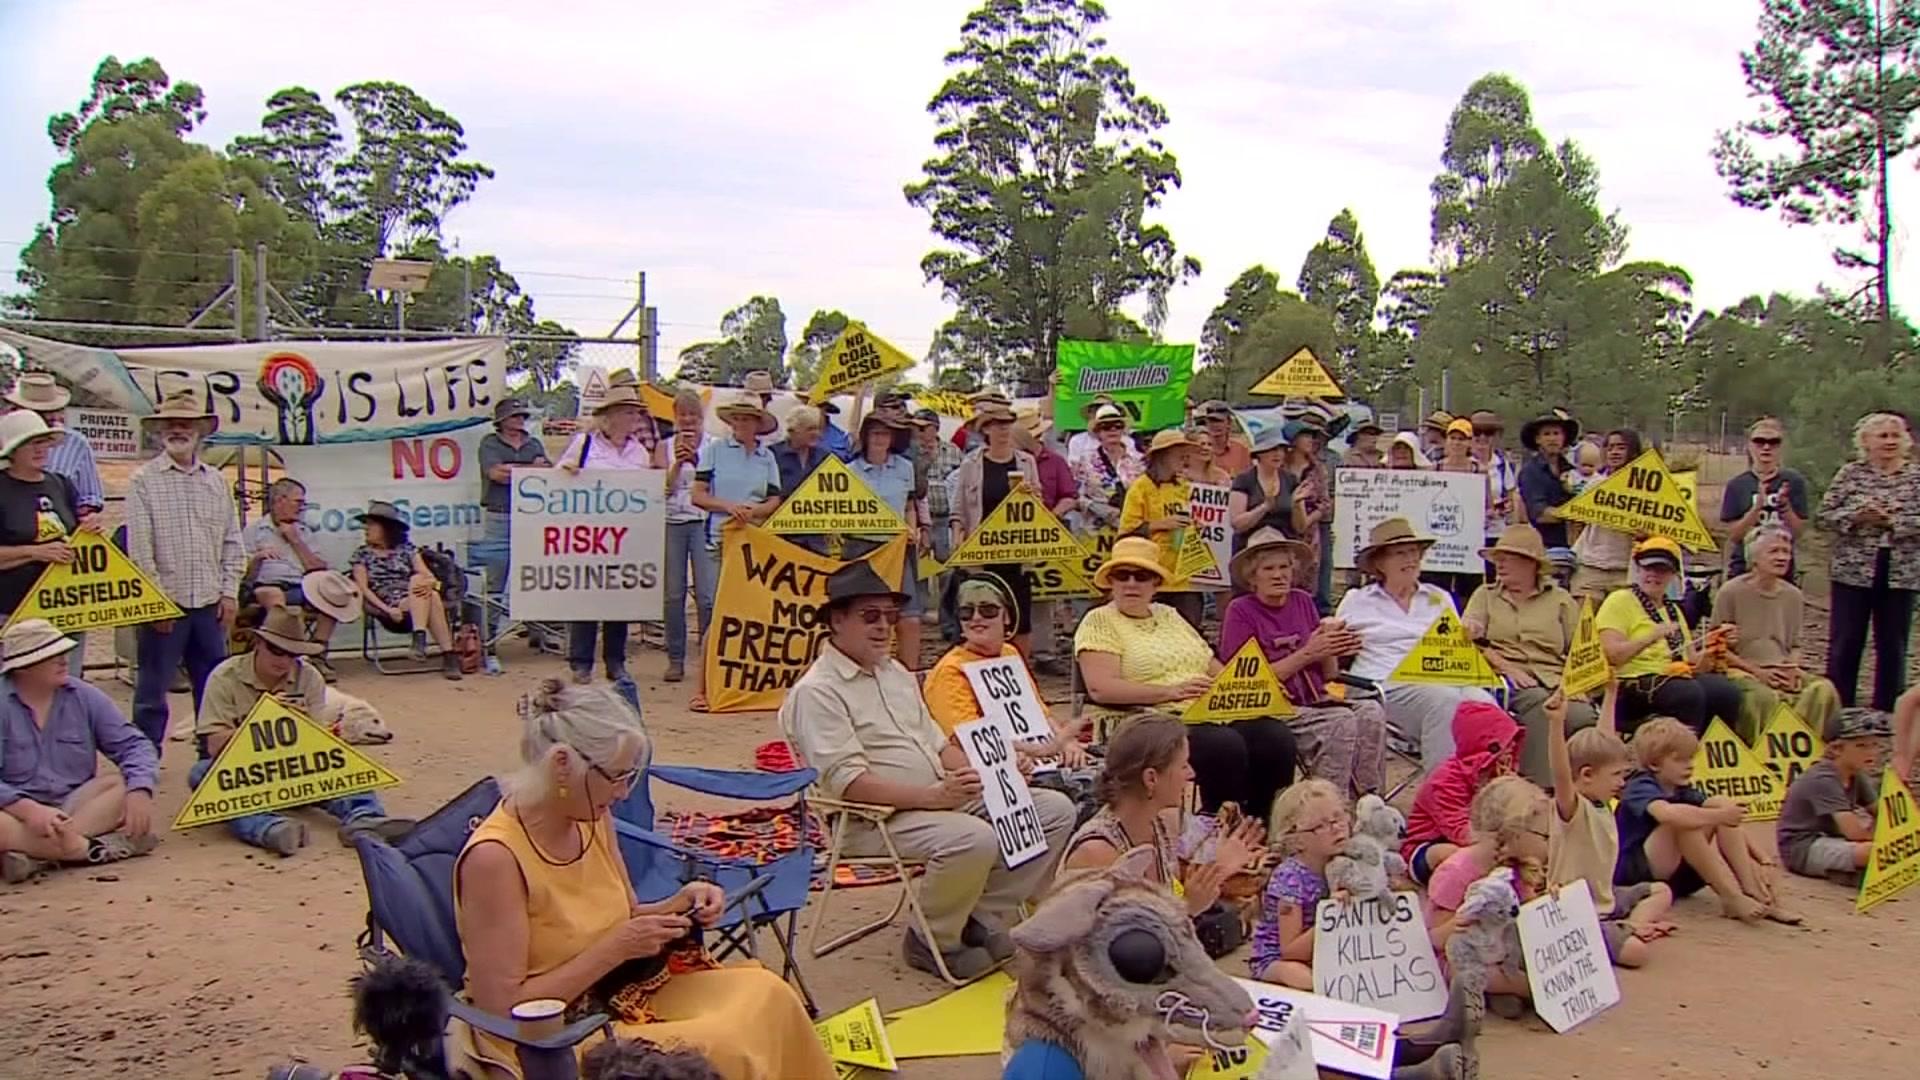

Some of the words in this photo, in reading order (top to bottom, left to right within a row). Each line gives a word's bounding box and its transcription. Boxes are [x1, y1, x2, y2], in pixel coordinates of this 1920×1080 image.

[838, 342, 877, 366] COAL
[846, 332, 864, 349] NO
[847, 355, 881, 380] CSG
[334, 369, 378, 425] IS
[394, 359, 491, 418] LIFE
[79, 413, 129, 427] PRIVATE
[107, 442, 137, 454] ENTER
[391, 437, 463, 481] NO
[817, 472, 849, 493] NO
[1627, 466, 1664, 493] NO
[517, 474, 648, 516] Santos
[791, 499, 878, 515] GASFIELDS
[1190, 487, 1230, 506] ARM
[1431, 503, 1460, 514] SAVE
[1593, 488, 1686, 524] GASFIELDS
[302, 501, 366, 533] Coa
[772, 518, 826, 529] PROTECT
[830, 518, 856, 528] OUR
[857, 518, 898, 528] WATER
[1006, 501, 1035, 523] NO
[1190, 505, 1227, 524] NOT
[1569, 504, 1626, 525] PROTECT
[1629, 516, 1656, 532] OUR
[1657, 525, 1703, 543] WATER
[543, 525, 629, 556] RISKY
[979, 527, 1060, 547] GASFIELDS
[1201, 526, 1225, 542] AS
[71, 544, 109, 575] NO
[960, 549, 1010, 561] PROTECT
[1014, 548, 1038, 559] OUR
[1040, 546, 1078, 558] WATER
[520, 562, 658, 592] BUSINESS
[741, 543, 831, 597] WAT
[1027, 568, 1063, 588] AS
[38, 578, 144, 610] GASFIELDS
[47, 612, 84, 628] TECT
[88, 607, 119, 624] OUR
[120, 601, 167, 619] WATER
[773, 598, 828, 631] MO
[980, 665, 1023, 700] CSG
[1234, 657, 1260, 679] NO
[1217, 679, 1269, 692] NARRABRI
[1208, 691, 1272, 711] GASFIELD
[1003, 701, 1030, 735] IS
[250, 716, 299, 752] NO
[970, 725, 1008, 767] CSG
[1767, 731, 1813, 760] NO
[1705, 740, 1739, 769] NO
[216, 748, 347, 792] GASFIELDS
[193, 790, 272, 817] PROTECT
[277, 783, 316, 801] OUR
[318, 770, 379, 793] WATER
[995, 769, 1018, 808] IS
[1687, 774, 1774, 800] ASFIELDS
[1884, 791, 1908, 830] NO
[996, 805, 1045, 857] OVER!
[1536, 901, 1569, 931] THE
[1337, 928, 1408, 968] KILLS
[1535, 927, 1589, 973] CHILDREN
[1324, 956, 1437, 1003] KOALAS
[1543, 966, 1578, 1001] KNOW
[1577, 952, 1600, 982] THE
[1561, 987, 1599, 1024] TRUTH
